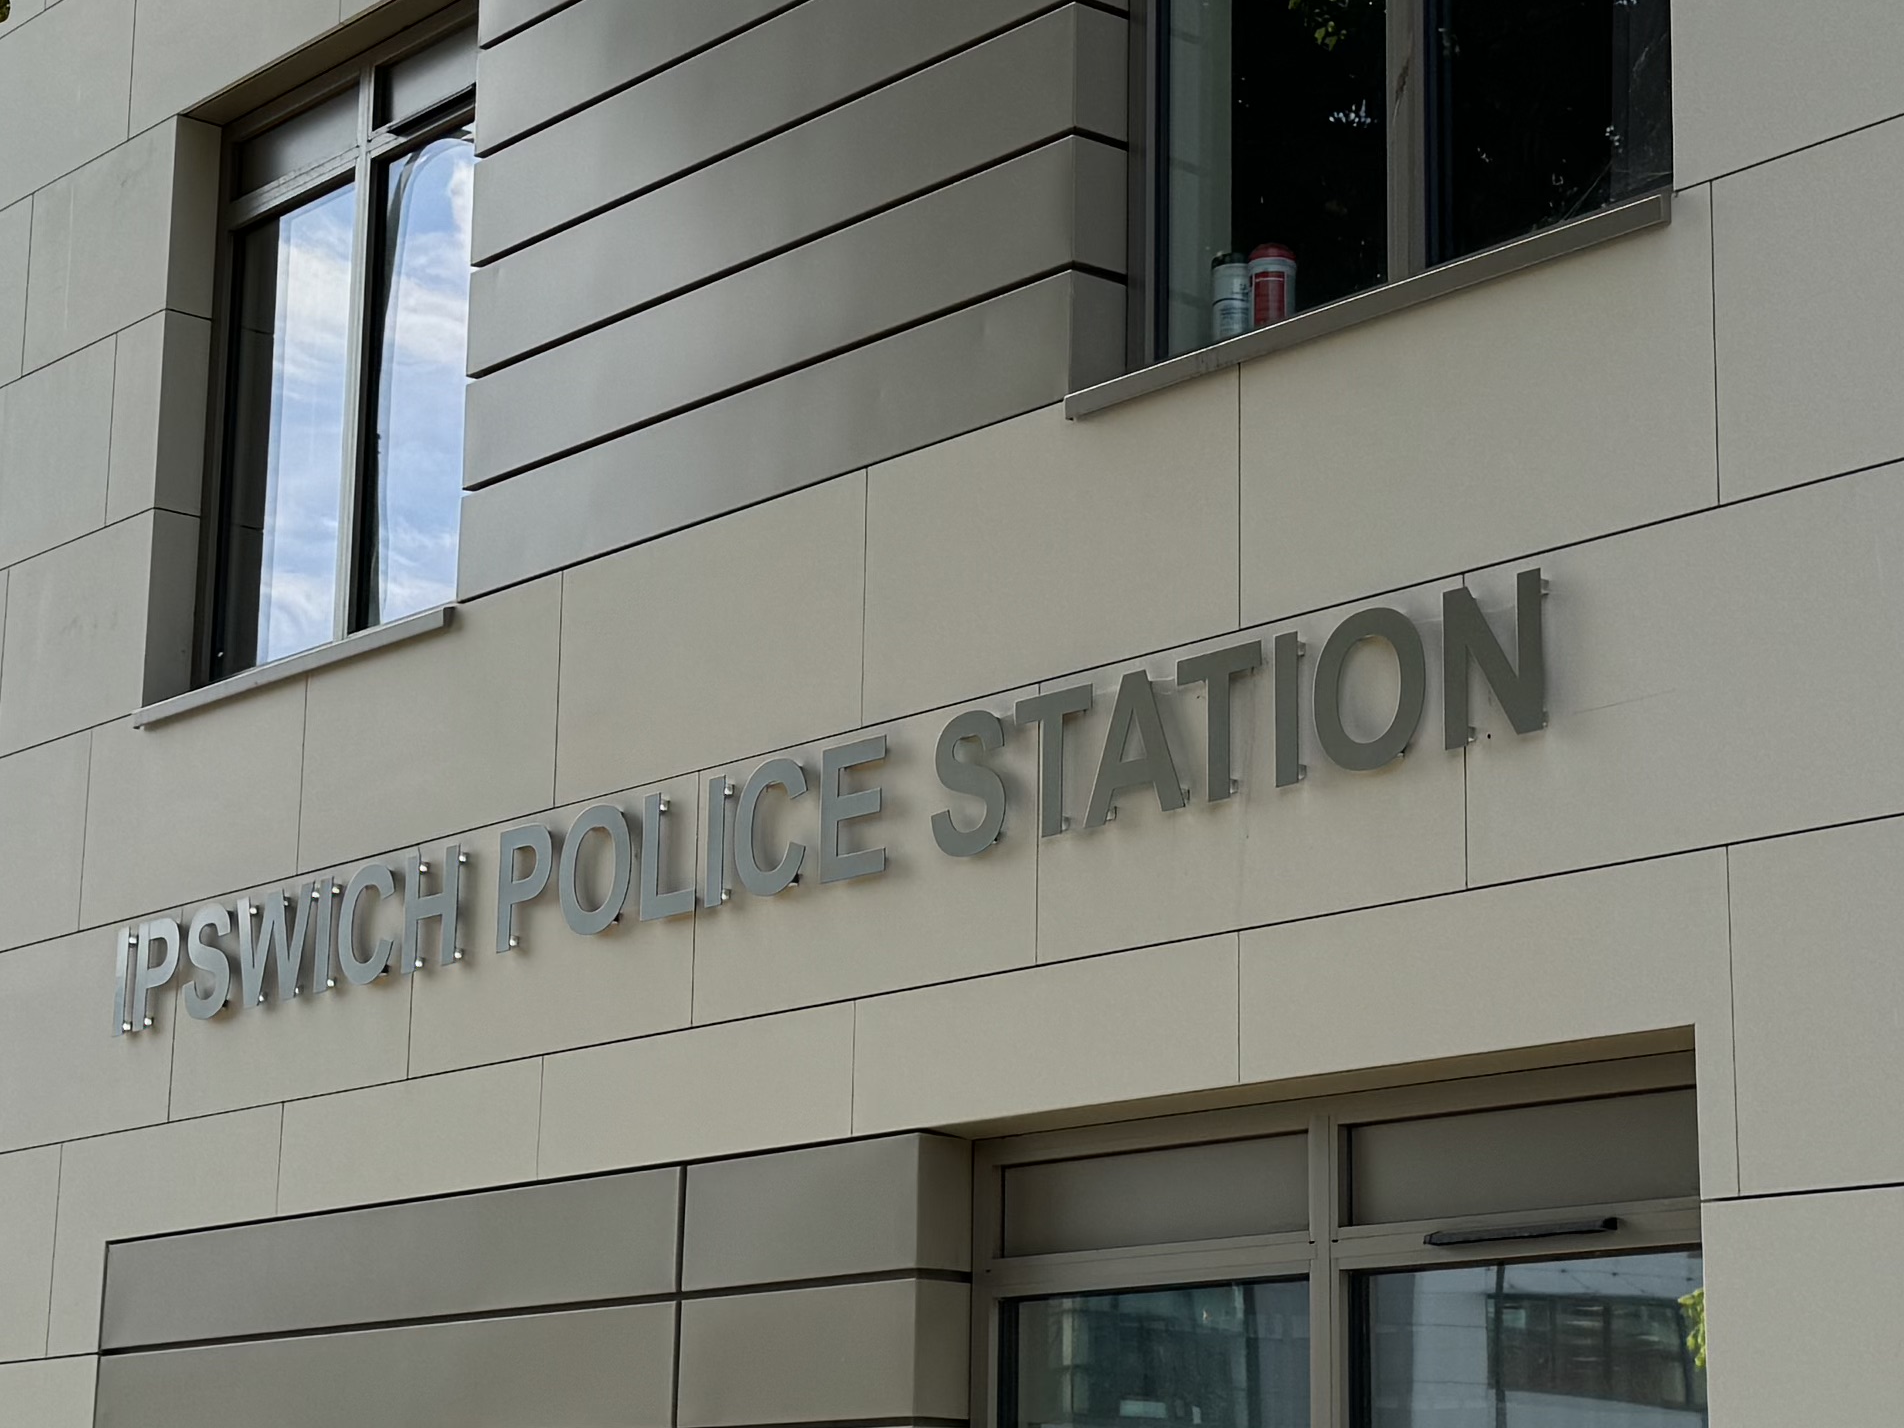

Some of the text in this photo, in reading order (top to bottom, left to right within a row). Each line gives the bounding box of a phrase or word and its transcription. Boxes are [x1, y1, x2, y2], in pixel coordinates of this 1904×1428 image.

[112, 567, 1547, 1036] IPSWICH POLICE STATION
